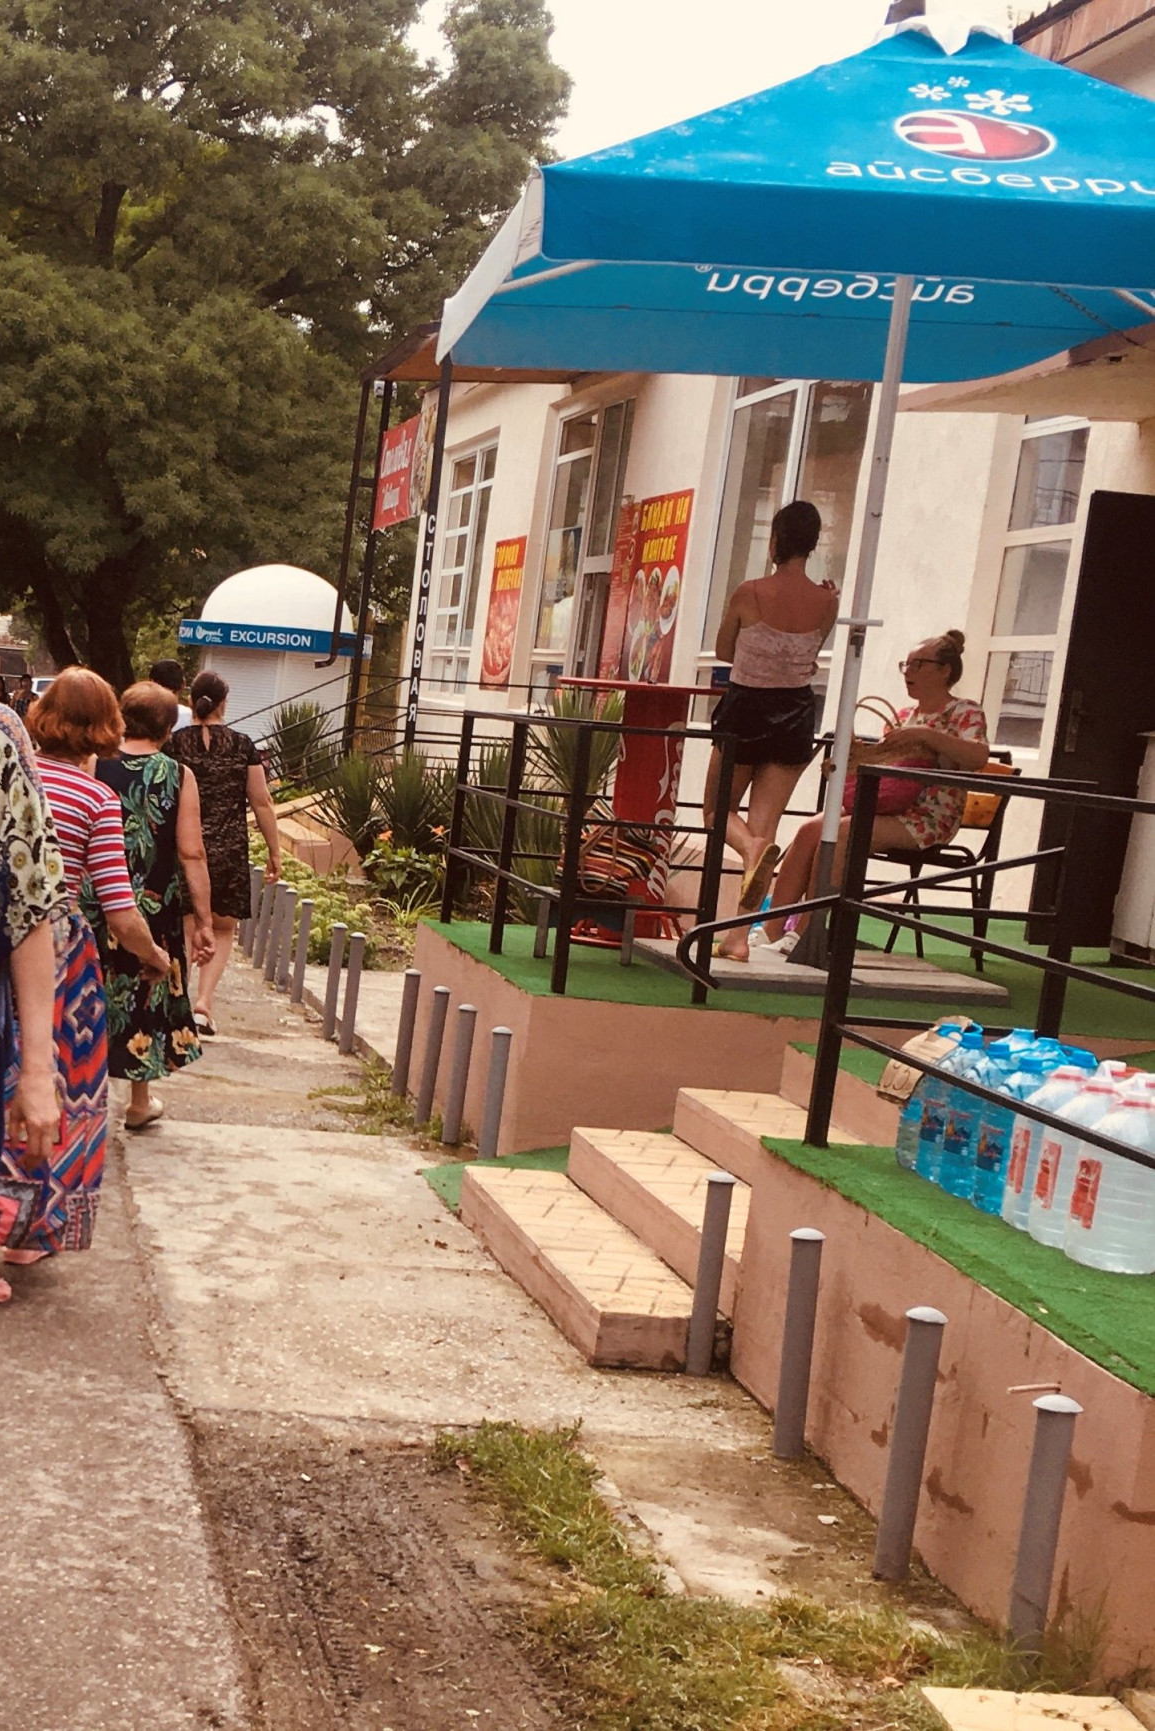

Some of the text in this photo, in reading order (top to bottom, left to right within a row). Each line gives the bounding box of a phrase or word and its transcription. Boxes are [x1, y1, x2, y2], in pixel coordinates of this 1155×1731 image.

[675, 495, 690, 525] НА
[407, 514, 436, 722] СТОЛОВАЯ
[230, 630, 311, 647] EXCURSION
